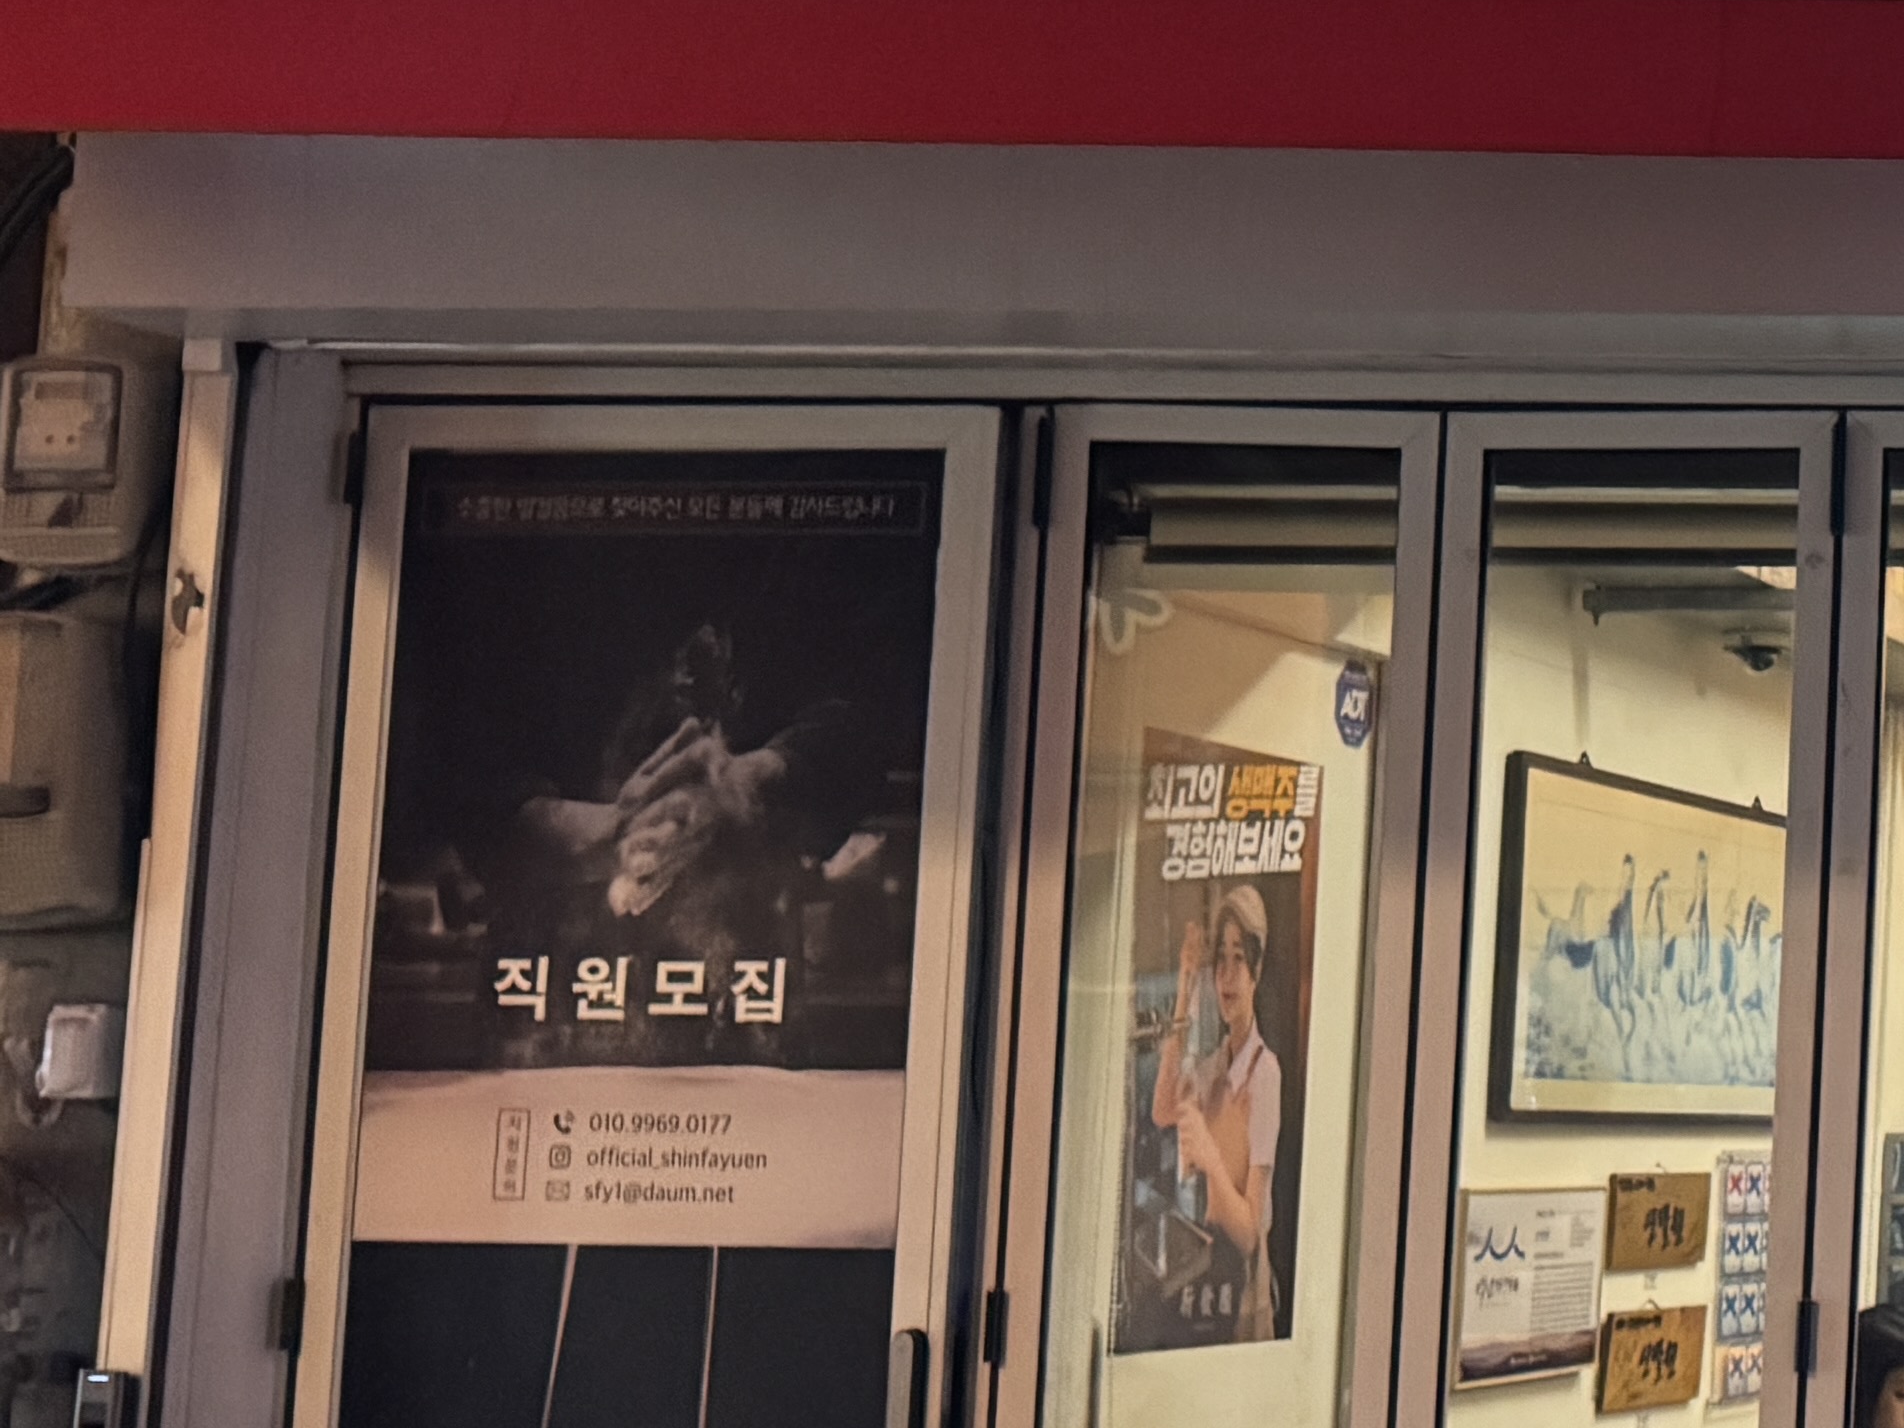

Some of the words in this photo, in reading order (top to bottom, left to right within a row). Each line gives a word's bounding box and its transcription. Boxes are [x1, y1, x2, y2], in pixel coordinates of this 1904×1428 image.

[1144, 762, 1225, 820] 최고의
[1226, 762, 1320, 821] 생맥주를
[1161, 818, 1307, 882] 경험해보세요
[492, 954, 787, 1024] 직원모집
[588, 1113, 733, 1136] 010.9969.0177
